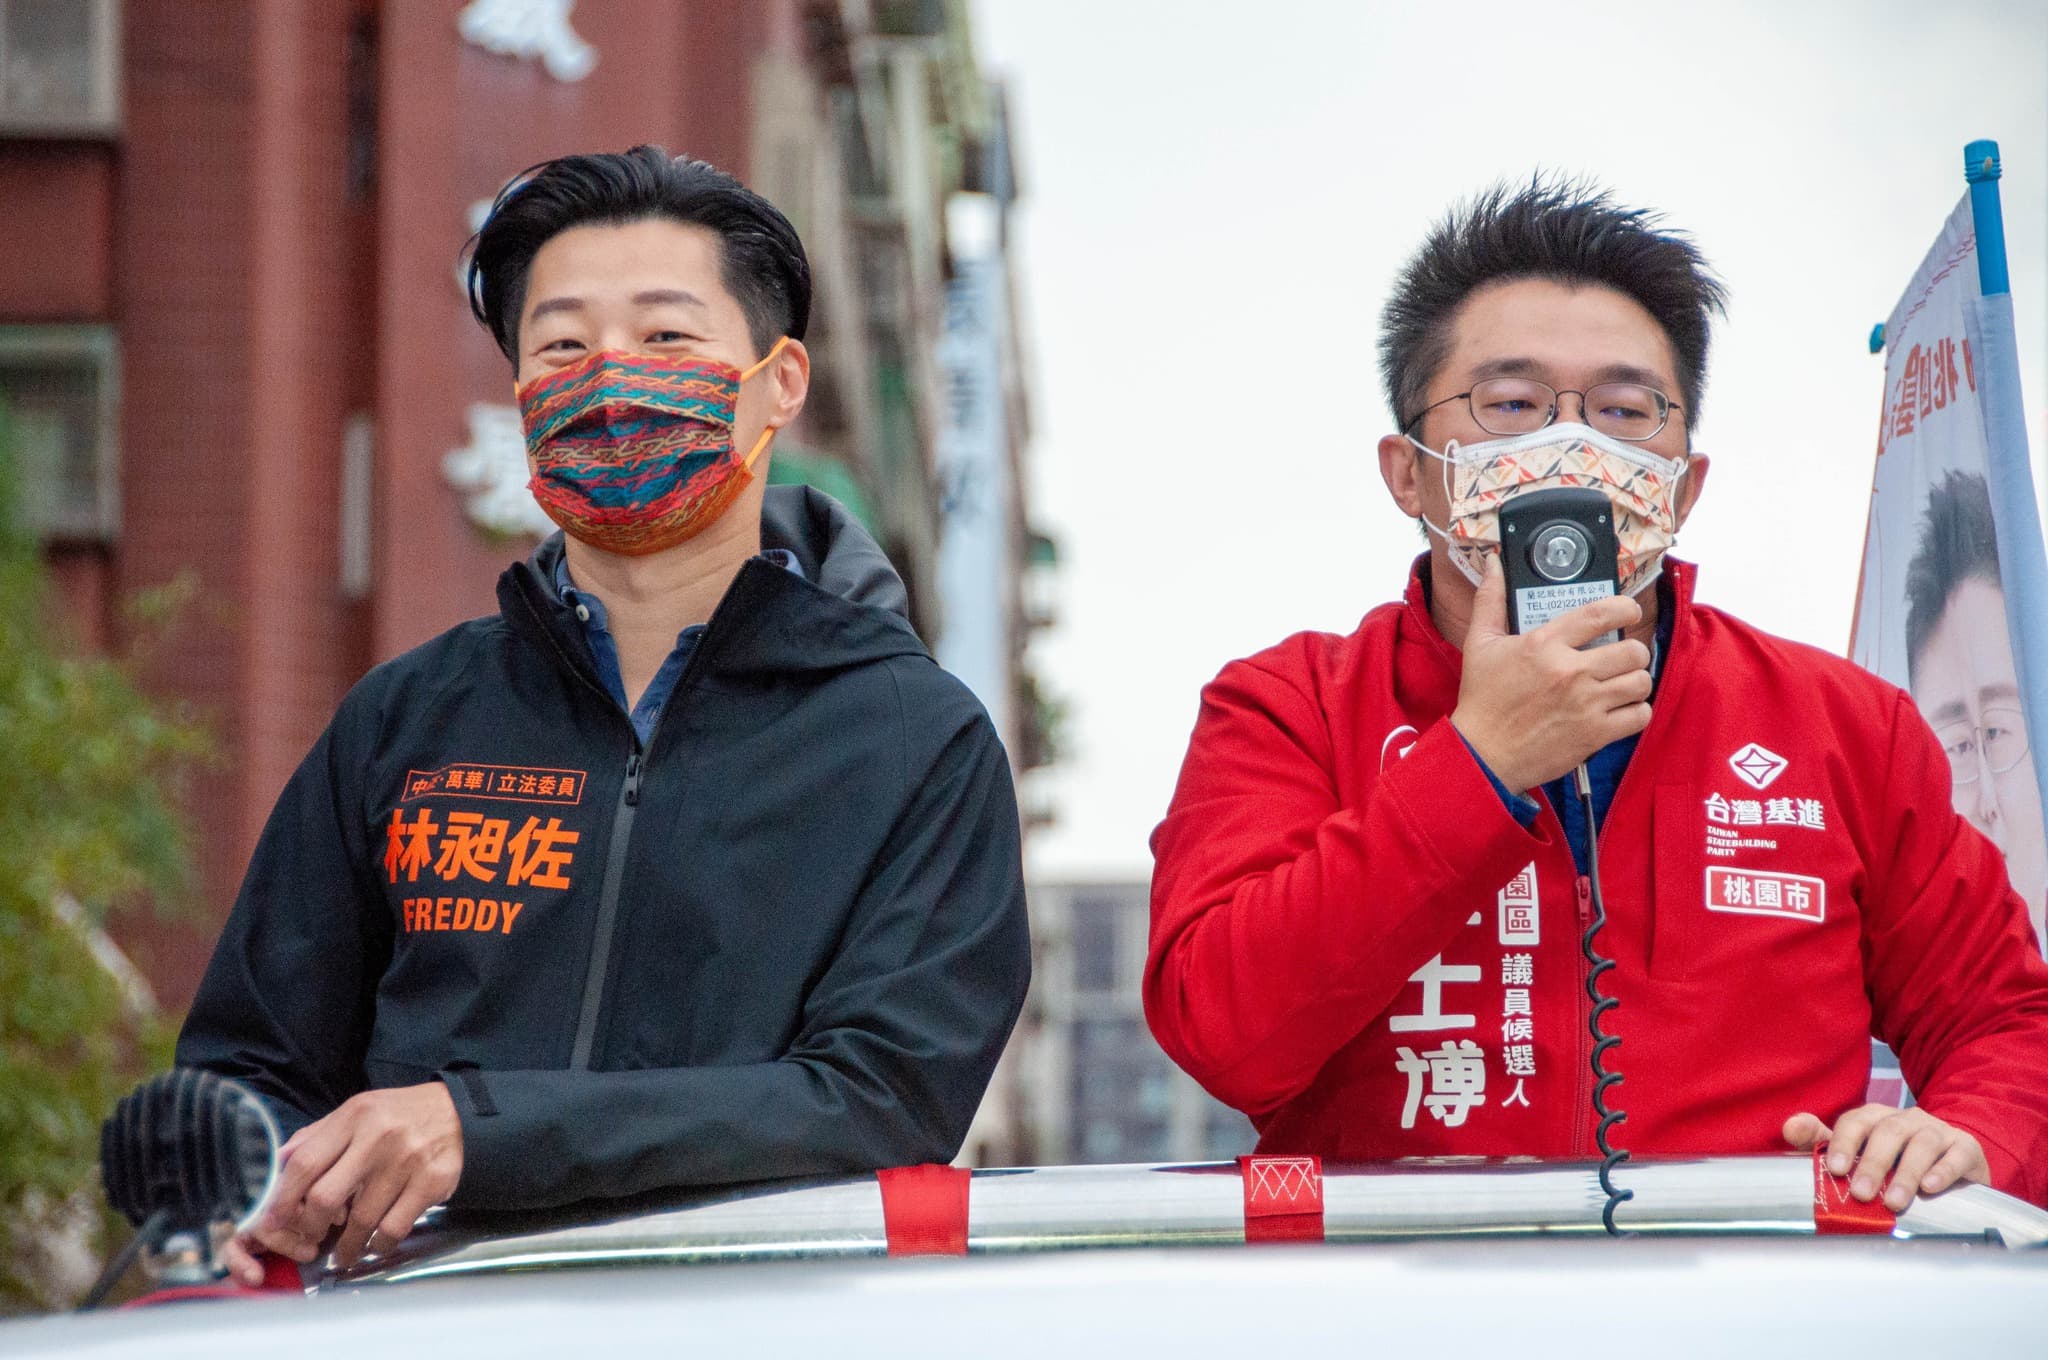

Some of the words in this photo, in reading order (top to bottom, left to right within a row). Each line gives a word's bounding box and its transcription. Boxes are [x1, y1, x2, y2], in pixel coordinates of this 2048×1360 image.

[497, 773, 576, 797] 立法委員
[1704, 792, 1825, 830] 台灣基進
[384, 808, 580, 889] 林昶佐
[1706, 836, 1777, 849] STATEBUILDING
[1707, 825, 1739, 838] TAIWAN
[1706, 846, 1737, 857] PARTY
[1723, 875, 1811, 911] 桃園市
[403, 897, 523, 935] FREDDY
[1389, 911, 1487, 1130] 士博
[1501, 953, 1536, 1108] 議員候選人
